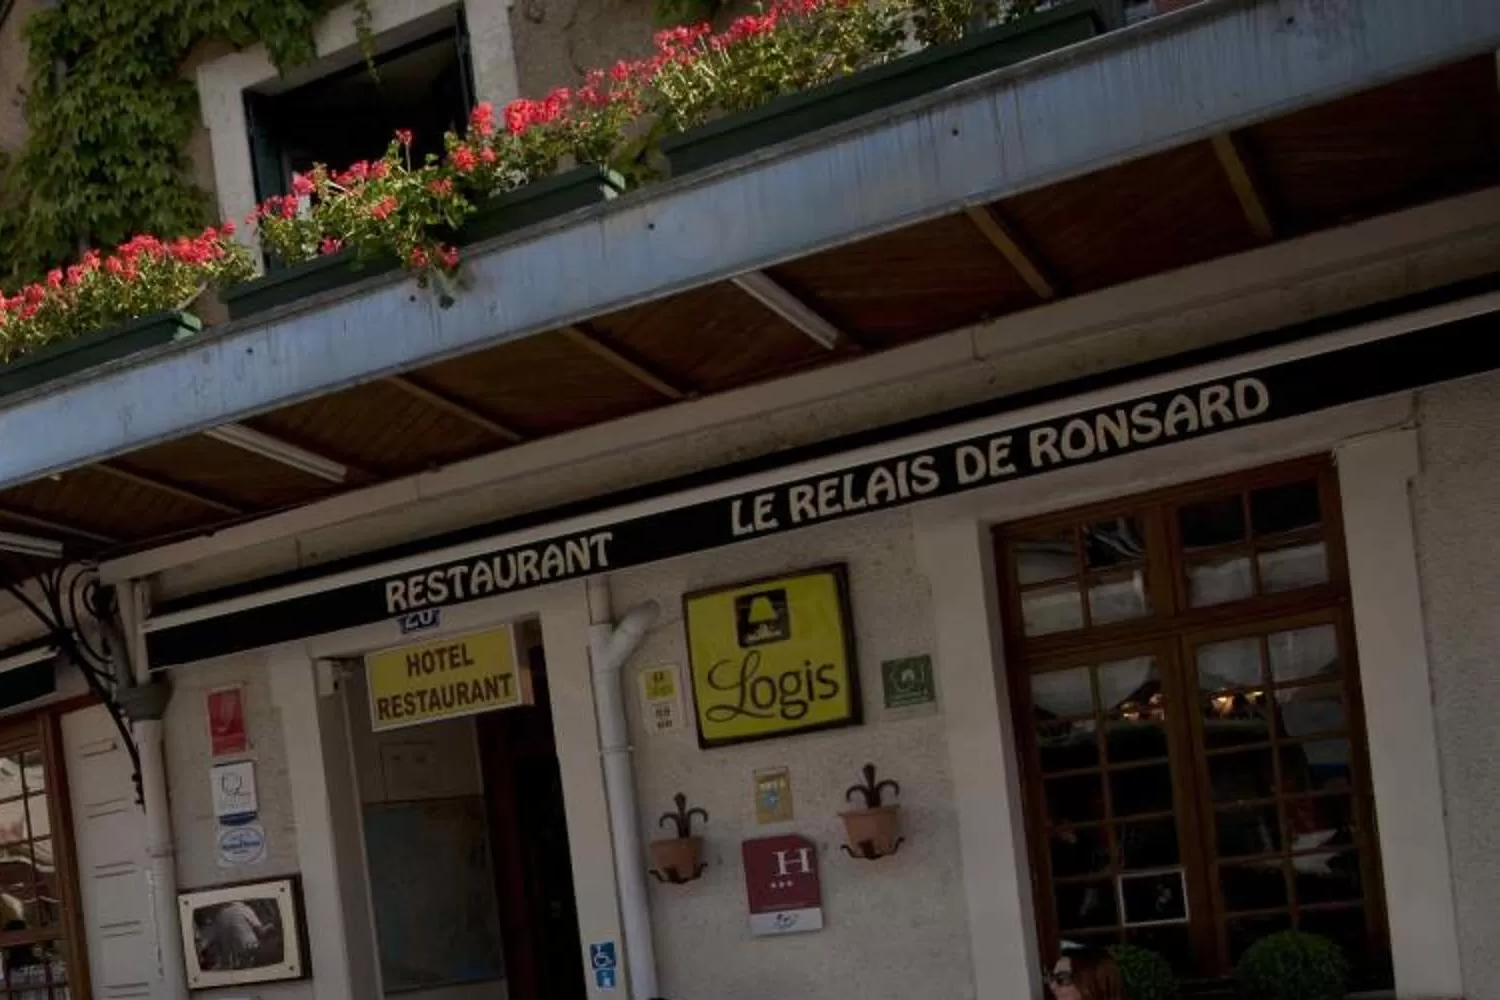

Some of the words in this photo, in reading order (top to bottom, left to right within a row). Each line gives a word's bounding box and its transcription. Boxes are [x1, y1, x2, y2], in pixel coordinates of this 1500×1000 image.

[730, 491, 778, 537] LE
[789, 455, 941, 525] RELAIS
[955, 436, 1018, 485] DE
[1029, 377, 1270, 468] RONSARD
[386, 532, 612, 613] RESTAURANT
[406, 642, 475, 678] HOTEL
[705, 649, 840, 723] Logis
[376, 673, 513, 721] RESTAURANT
[772, 848, 812, 876] H
